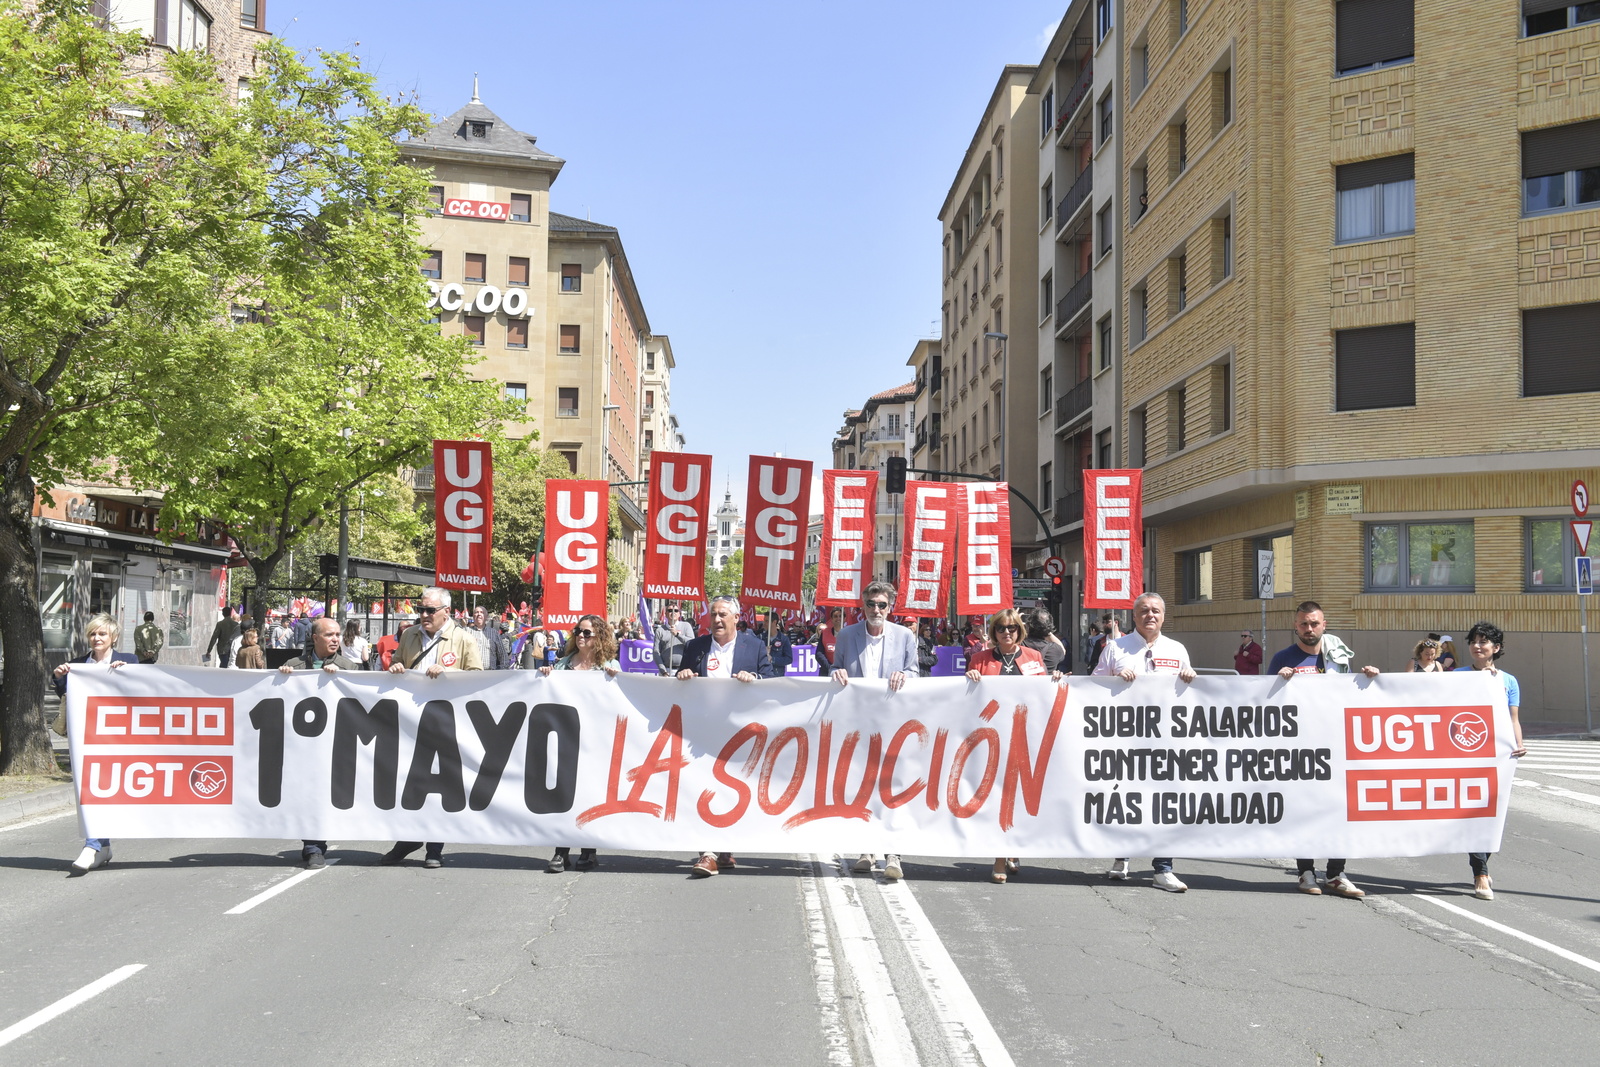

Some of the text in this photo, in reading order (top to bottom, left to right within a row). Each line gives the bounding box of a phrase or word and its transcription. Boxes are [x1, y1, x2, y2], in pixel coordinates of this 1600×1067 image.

[97, 500, 120, 525] bar
[130, 508, 149, 530] LA
[443, 449, 484, 571] UGT
[655, 461, 702, 583] UGT
[754, 464, 802, 586] UGT
[554, 491, 599, 611] UGT
[438, 572, 487, 586] NAVARRA
[647, 583, 700, 597] NAVARRA
[745, 587, 797, 602] NAVARRA
[1261, 573, 1272, 586] 30
[548, 614, 601, 624] NAVA
[96, 706, 226, 736] CCOO
[1083, 704, 1299, 739] SUBIR SALARIOS
[1353, 714, 1441, 754] UGT
[576, 682, 1069, 833] LA SOLUCIÓN
[1084, 747, 1332, 782] CONTENER PRECIOS
[88, 761, 183, 799] UGT
[1357, 777, 1490, 811] CCOO
[1083, 783, 1284, 825] MÁS IGUALDAD
